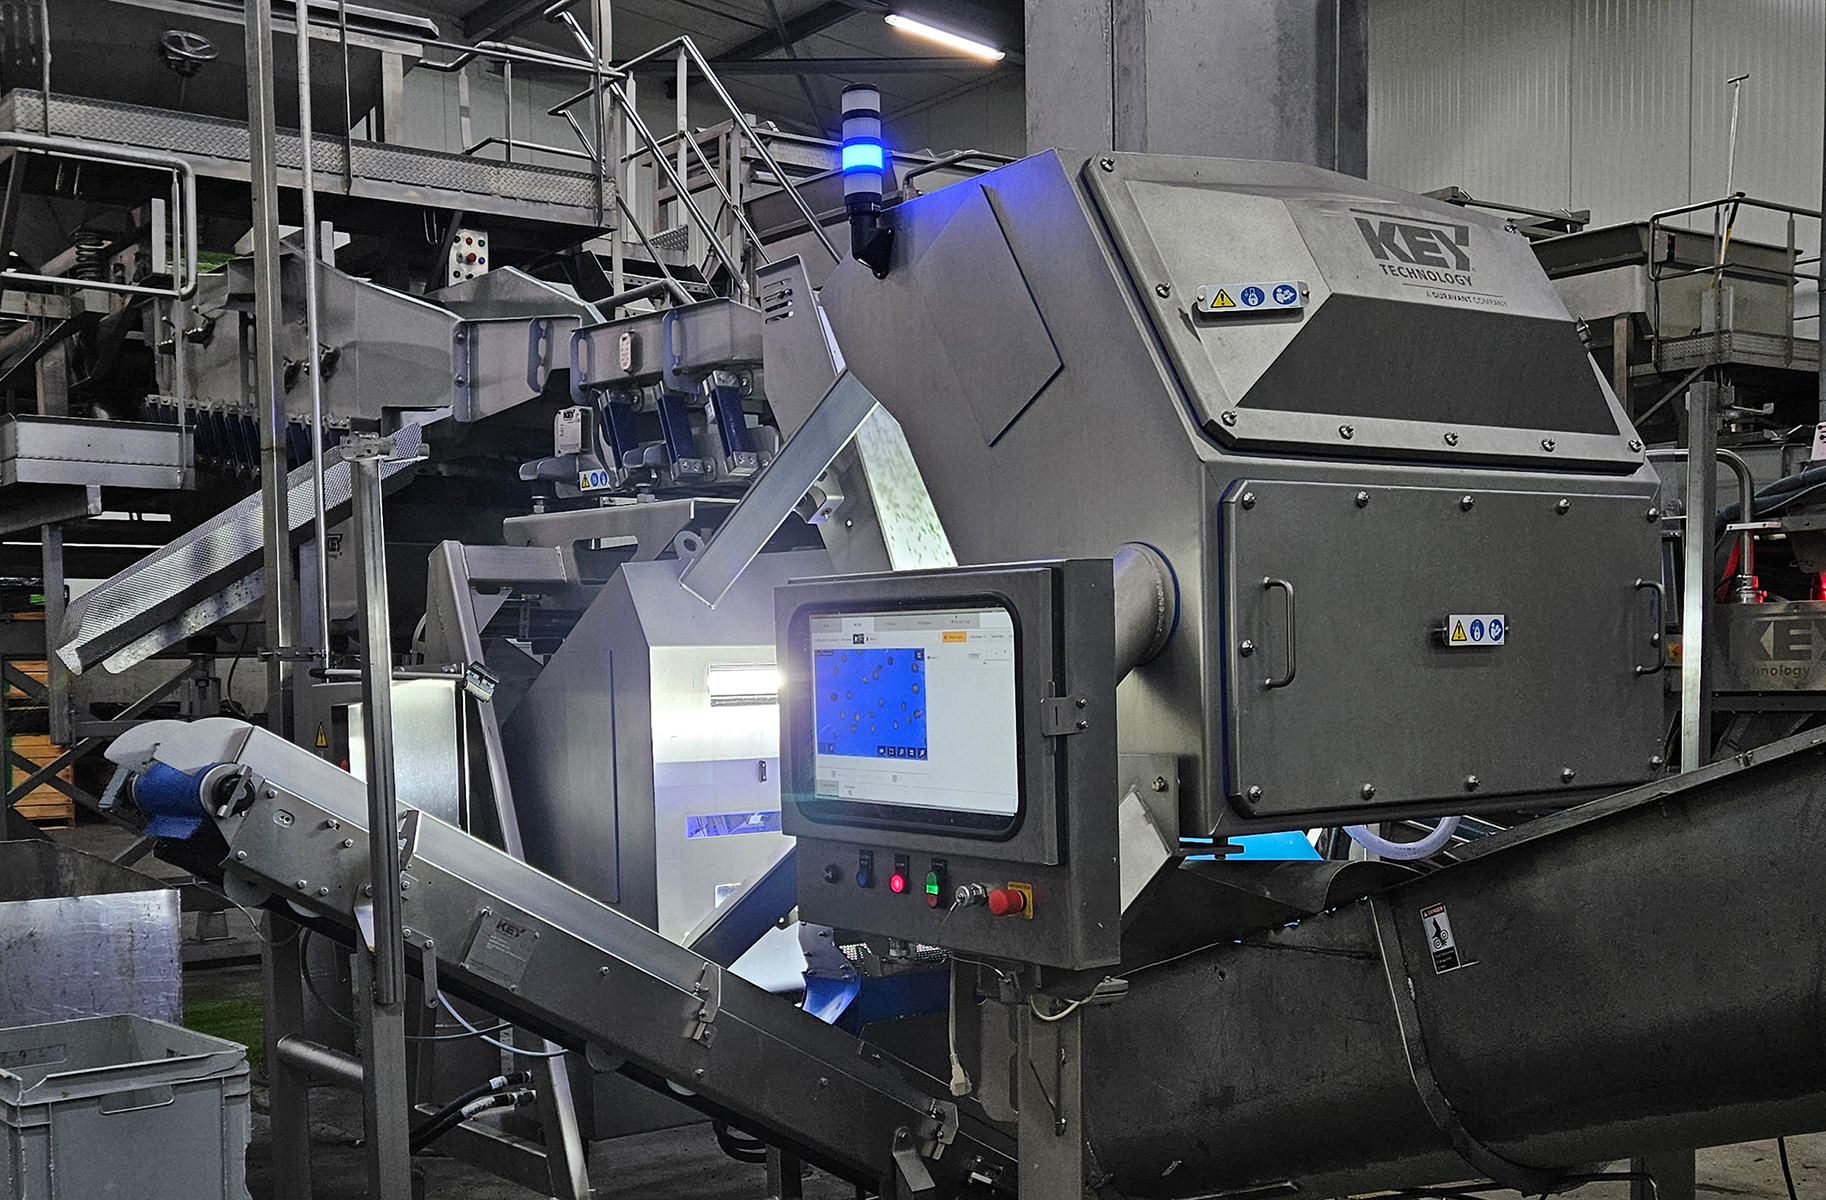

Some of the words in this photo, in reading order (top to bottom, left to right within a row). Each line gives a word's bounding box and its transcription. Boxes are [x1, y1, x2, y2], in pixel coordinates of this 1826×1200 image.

[1350, 208, 1470, 272] KEY
[1379, 264, 1473, 287] TECHNOLOGY
[1432, 292, 1473, 304] DURAVANT
[1472, 296, 1508, 308] COMPANY
[327, 534, 343, 552] EY
[496, 920, 527, 938] KEY
